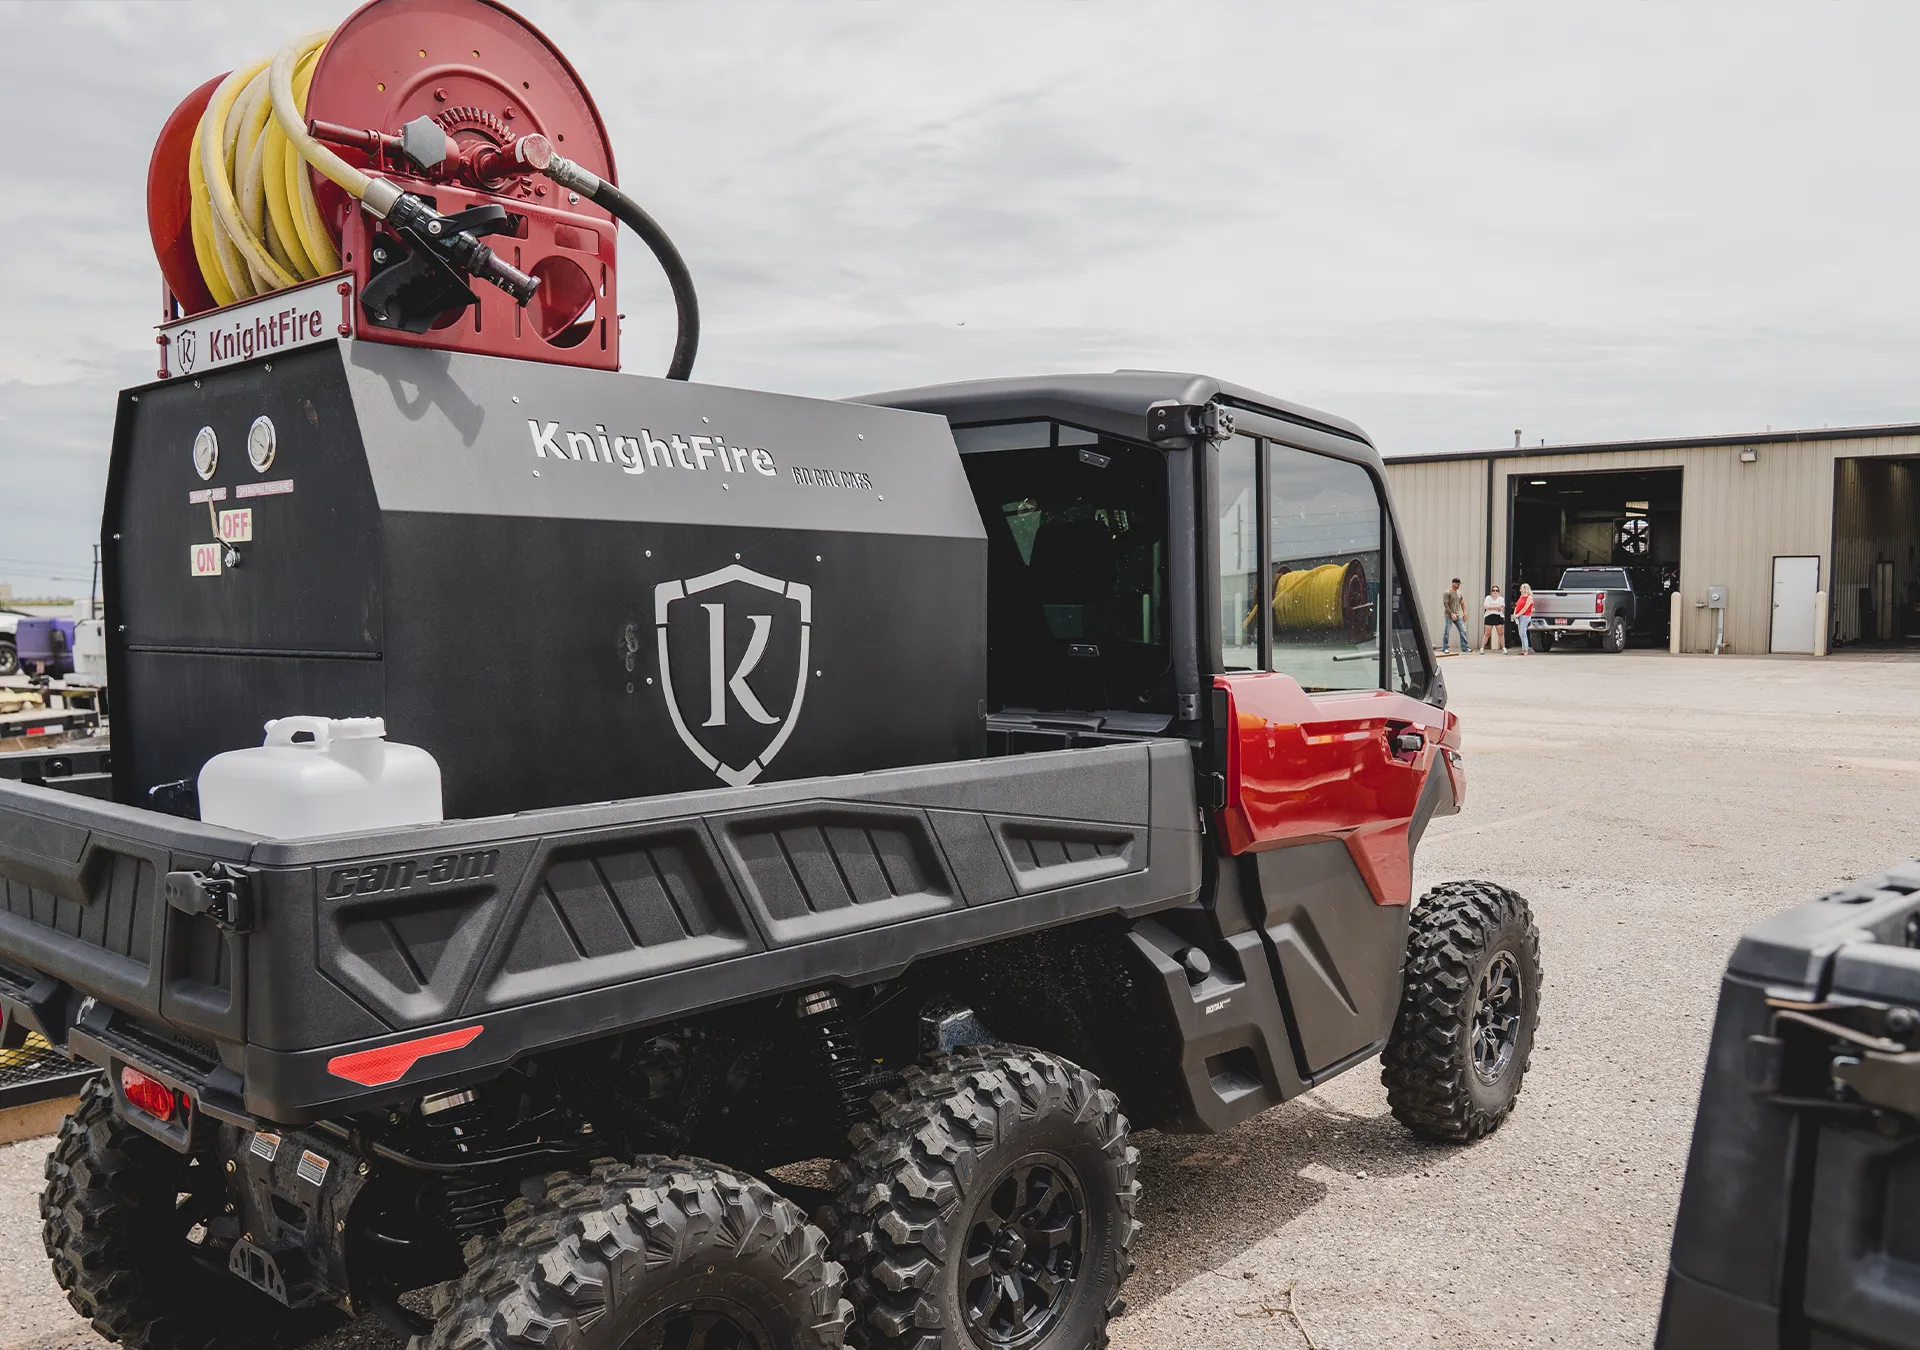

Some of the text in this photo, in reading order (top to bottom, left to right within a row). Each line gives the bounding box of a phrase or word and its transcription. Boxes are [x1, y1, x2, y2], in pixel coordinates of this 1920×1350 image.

[210, 307, 323, 360] KnightFire
[528, 418, 777, 475] KnightFire
[791, 466, 813, 486] 60
[813, 468, 840, 488] GAL
[222, 512, 249, 539] OFF
[196, 547, 216, 573] ON
[700, 603, 782, 727] K
[325, 848, 501, 901] can-am
